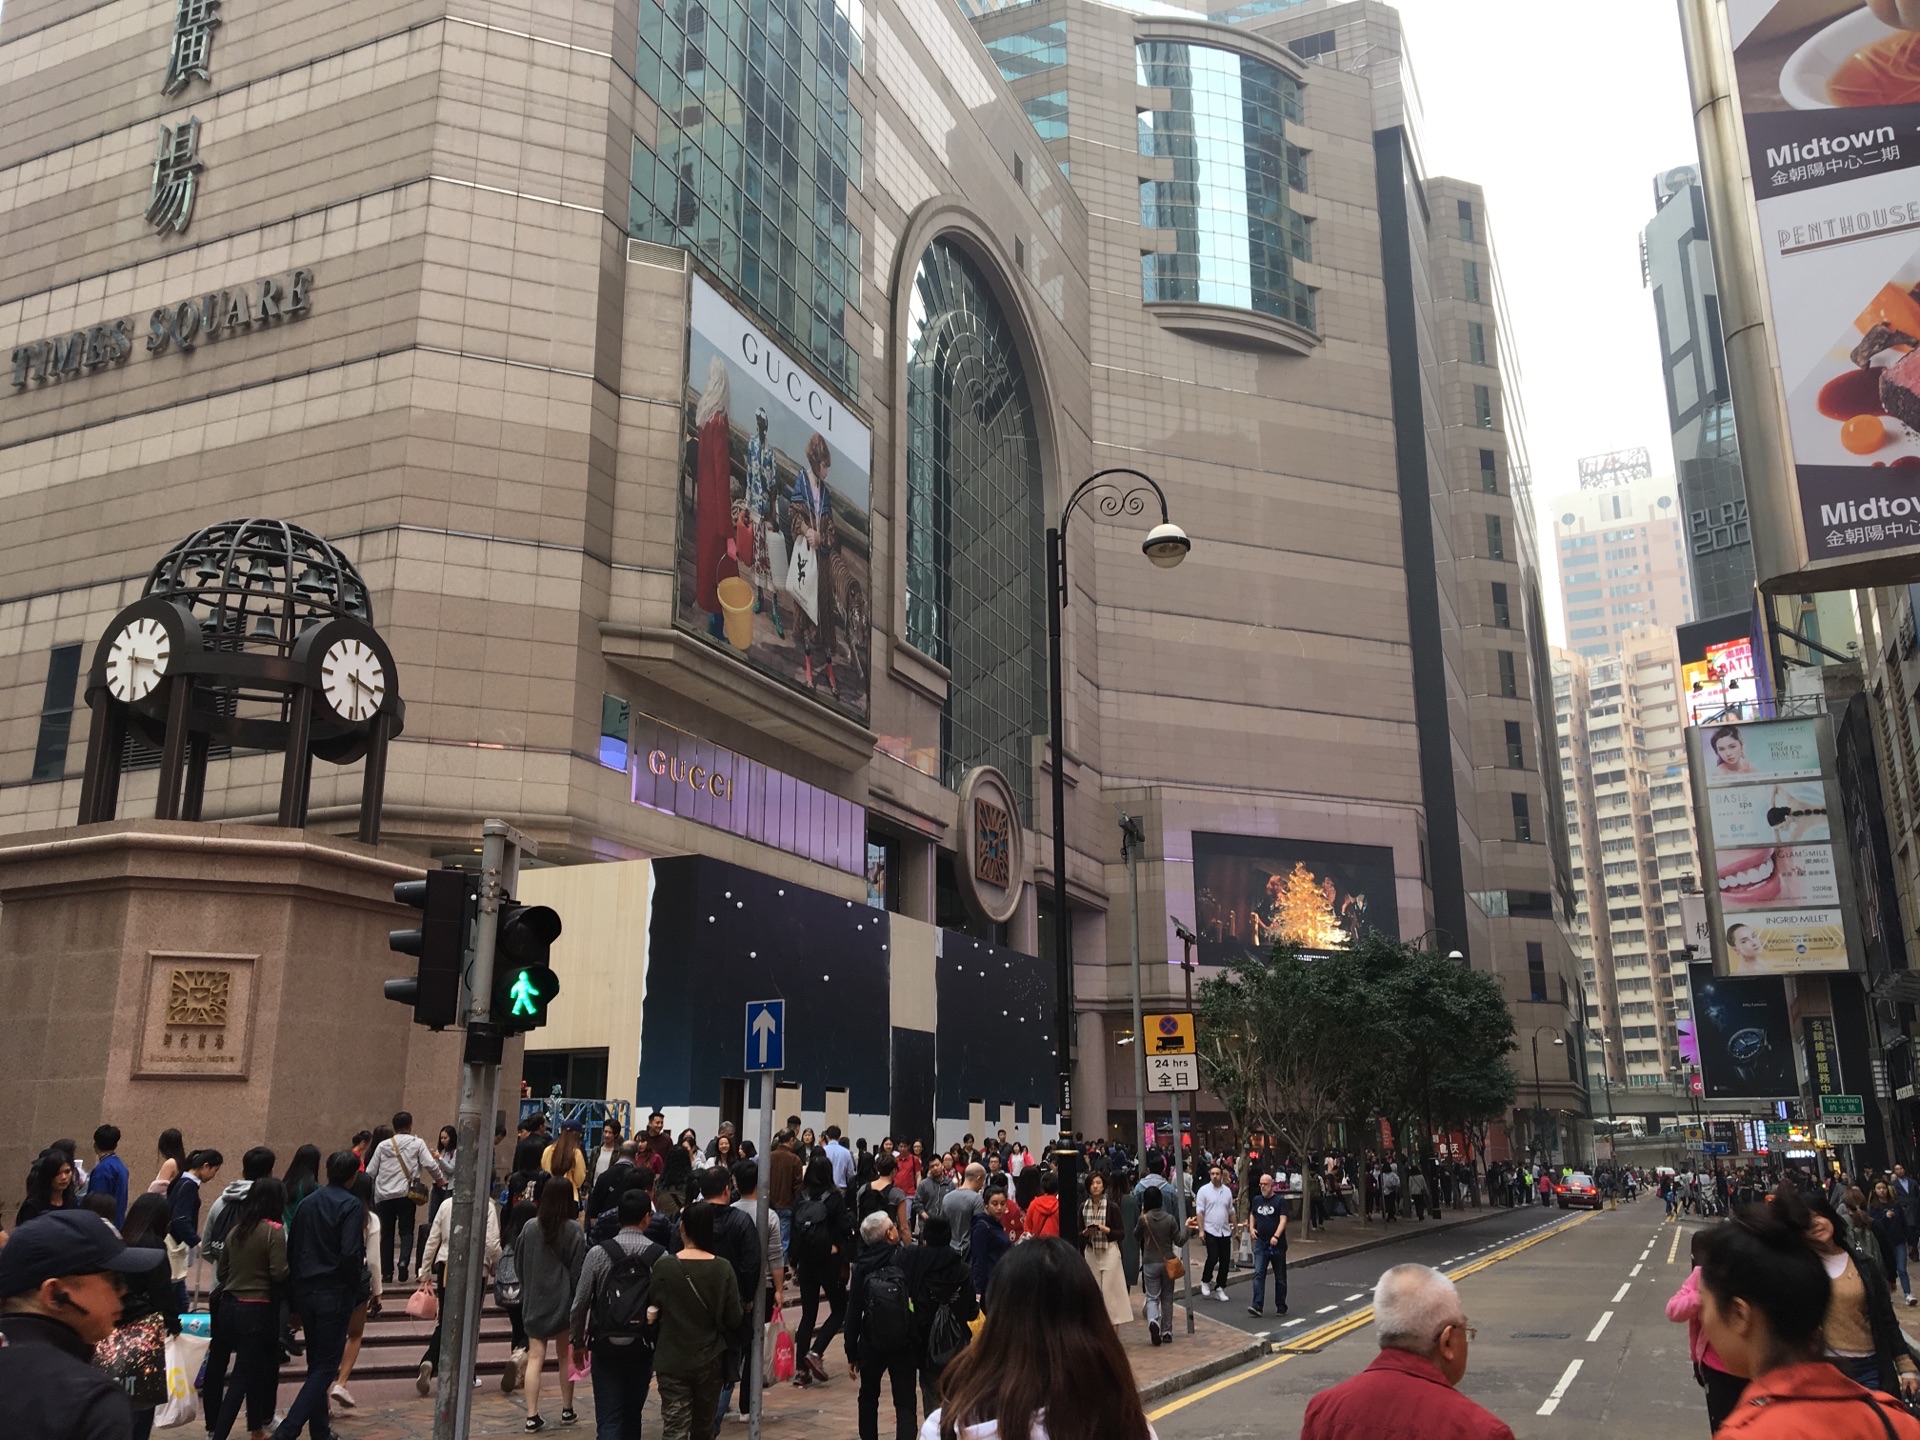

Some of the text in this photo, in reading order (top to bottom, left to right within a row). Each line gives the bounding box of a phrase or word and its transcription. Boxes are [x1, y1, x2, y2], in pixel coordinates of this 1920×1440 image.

[1766, 125, 1895, 169] Midtown
[1770, 144, 1900, 187] 金朝陽中心二期
[1777, 201, 1920, 249] PENTHOUSE
[11, 267, 315, 389] TIMES SQUARE
[741, 332, 834, 433] GUCCI
[1826, 518, 1920, 548] 金朝陽中心
[648, 749, 734, 802] GUCCI
[1715, 792, 1749, 805] OASIS
[1739, 801, 1753, 810] spa
[1765, 914, 1829, 925] INGRID MILLET
[1154, 1058, 1189, 1068] 24 hrs
[1158, 1072, 1189, 1088] 全日
[1833, 1116, 1843, 1124] 12
